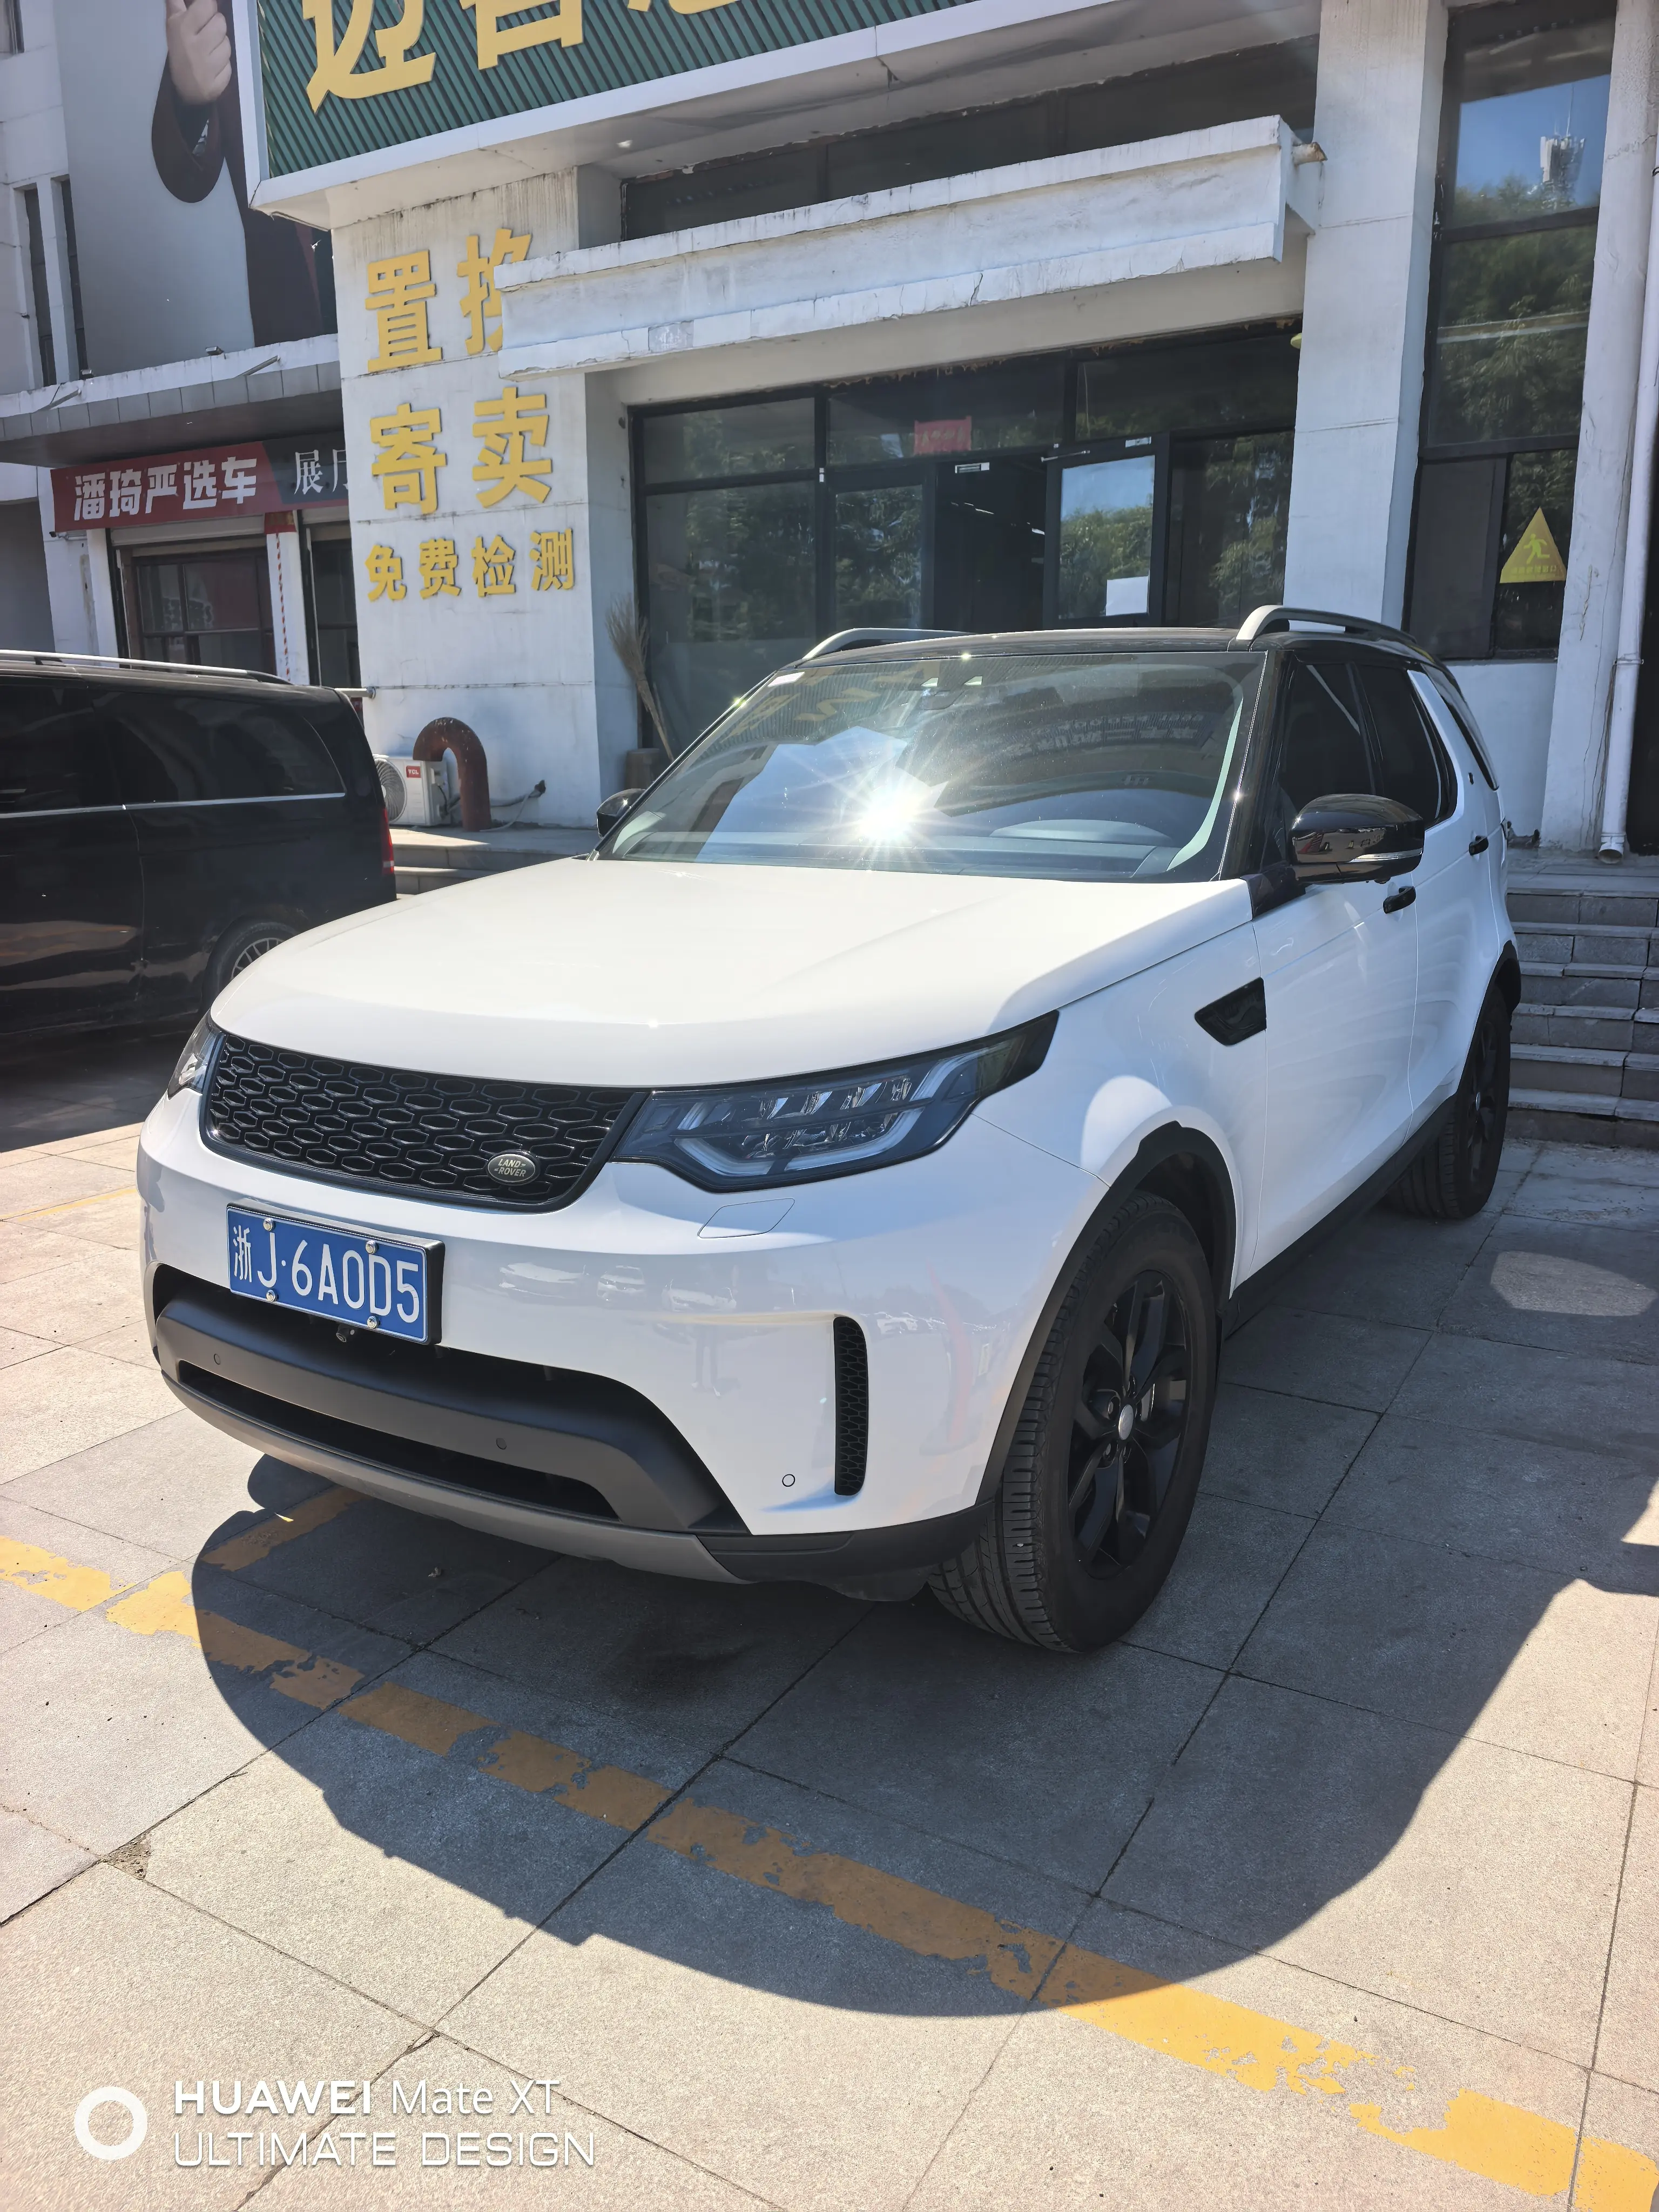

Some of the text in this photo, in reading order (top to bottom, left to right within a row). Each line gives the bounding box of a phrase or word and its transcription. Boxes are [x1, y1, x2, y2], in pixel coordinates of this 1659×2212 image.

[370, 387, 553, 515] 寄卖
[74, 456, 257, 521] 潘琦严选车
[365, 528, 575, 602] 免费检测
[498, 1158, 521, 1168] LAND
[498, 1166, 527, 1177] ROVER
